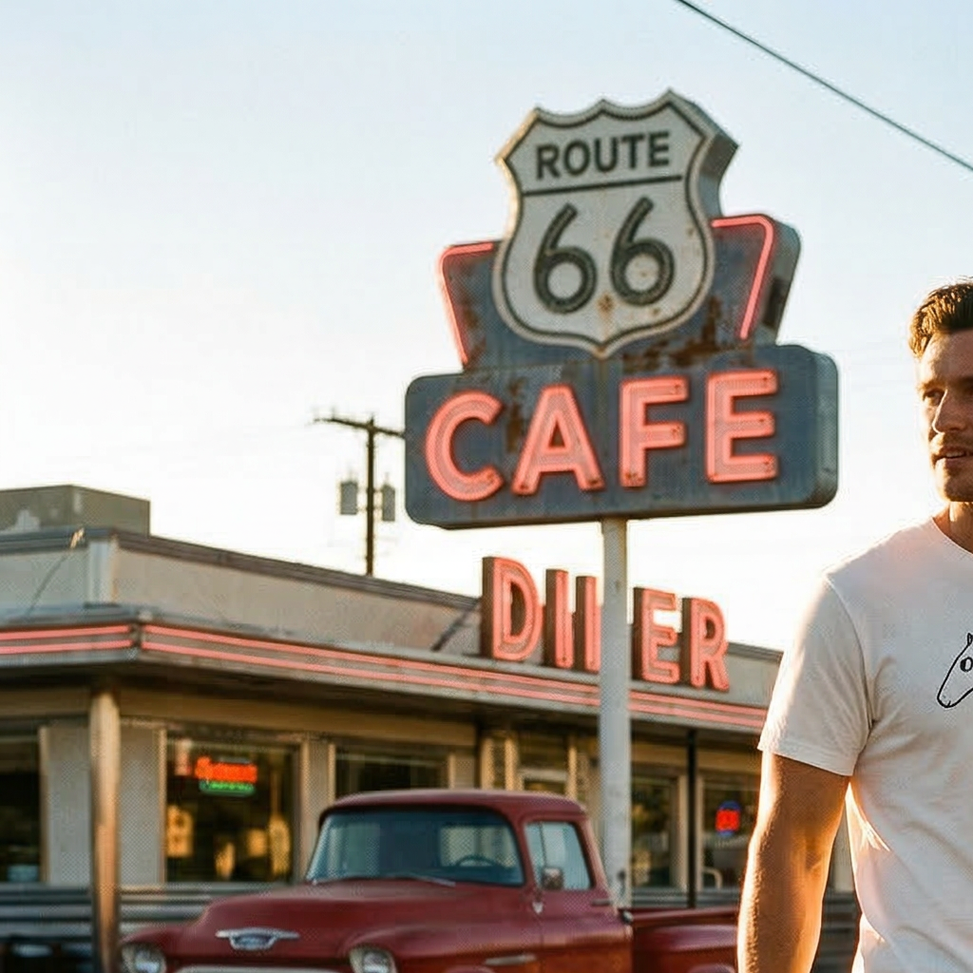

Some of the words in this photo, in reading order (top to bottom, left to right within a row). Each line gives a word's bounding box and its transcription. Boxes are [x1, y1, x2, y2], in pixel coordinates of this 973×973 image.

[535, 131, 672, 181] ROUTE
[532, 196, 675, 315] 66
[424, 368, 779, 502] CAFE
